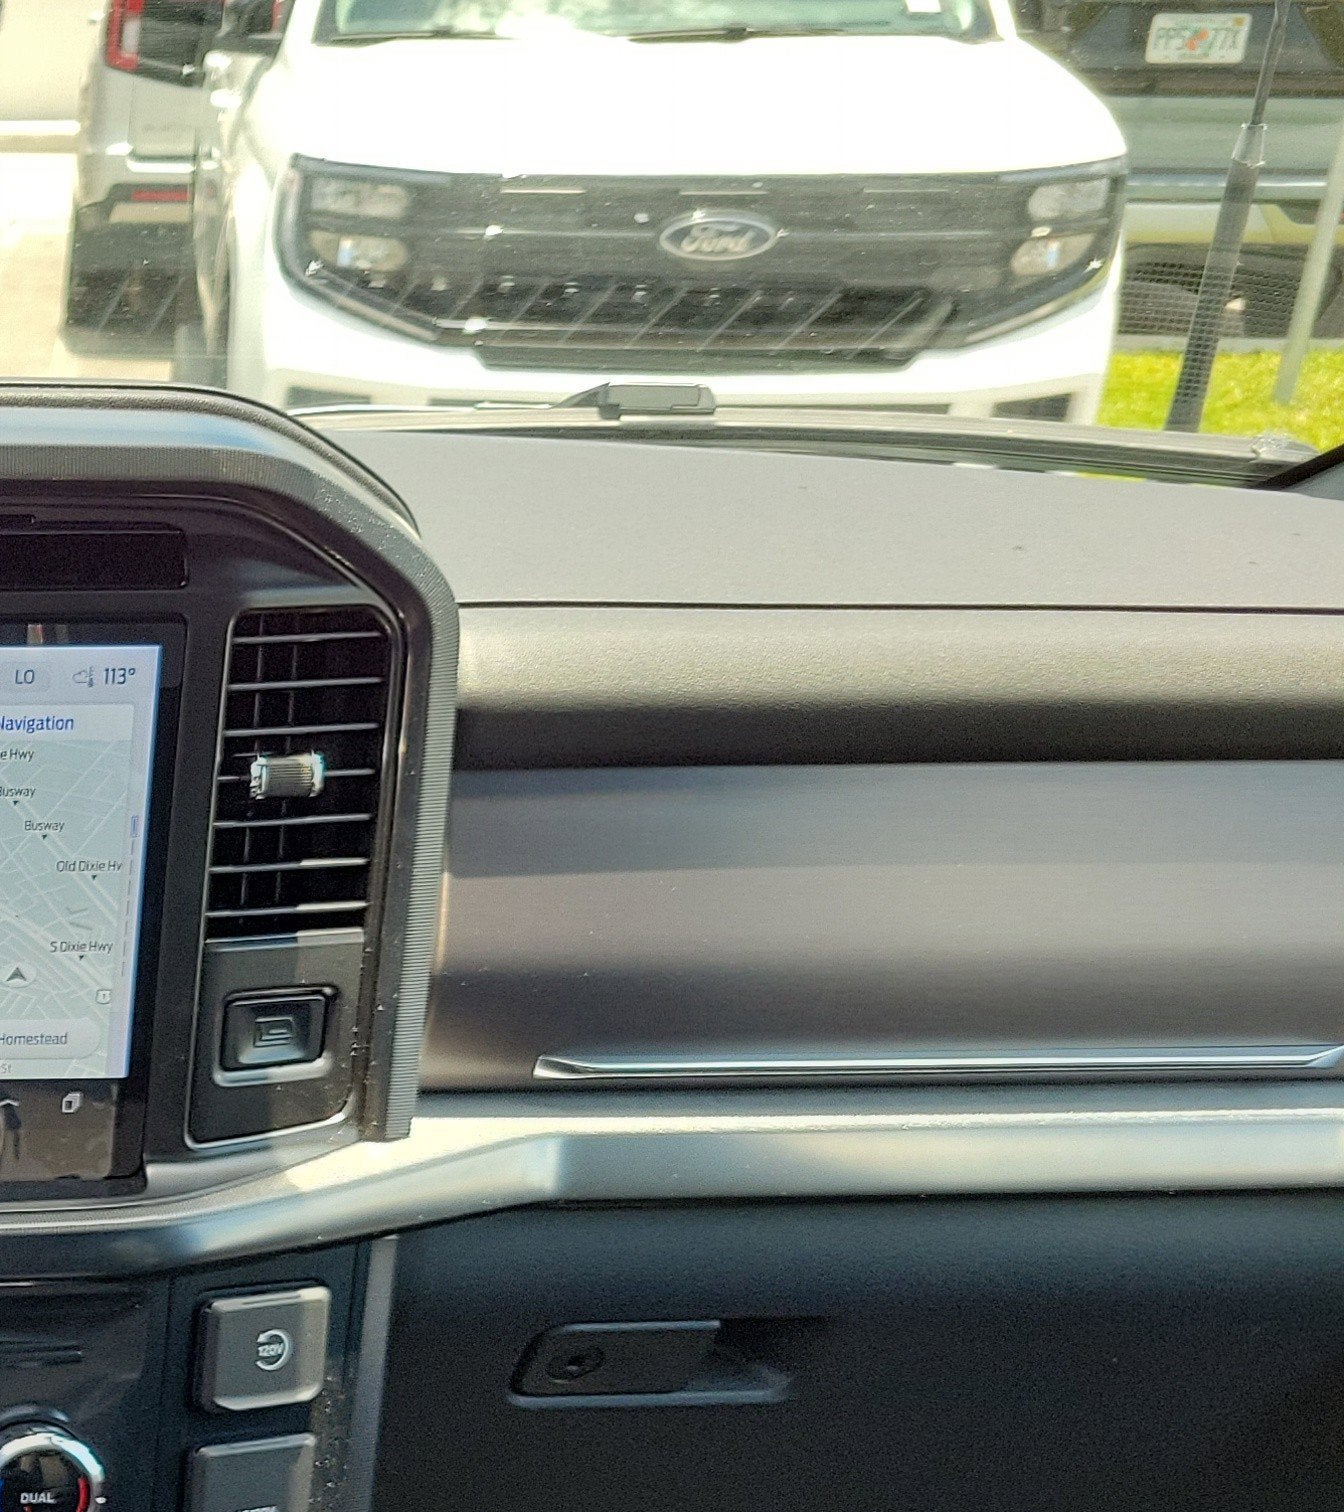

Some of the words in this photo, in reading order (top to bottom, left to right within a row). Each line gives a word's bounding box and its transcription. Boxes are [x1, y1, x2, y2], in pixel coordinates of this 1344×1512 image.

[14, 669, 36, 686] LO
[103, 667, 138, 686] 113°
[9, 749, 35, 764] Hwy
[23, 820, 65, 833] Busway
[56, 859, 77, 873] Old
[78, 860, 106, 872] Dixie
[50, 941, 59, 953] S
[60, 941, 88, 953] Dixie
[88, 941, 114, 955] Hwy
[0, 1063, 12, 1074] St
[19, 1492, 55, 1504] DUAL
